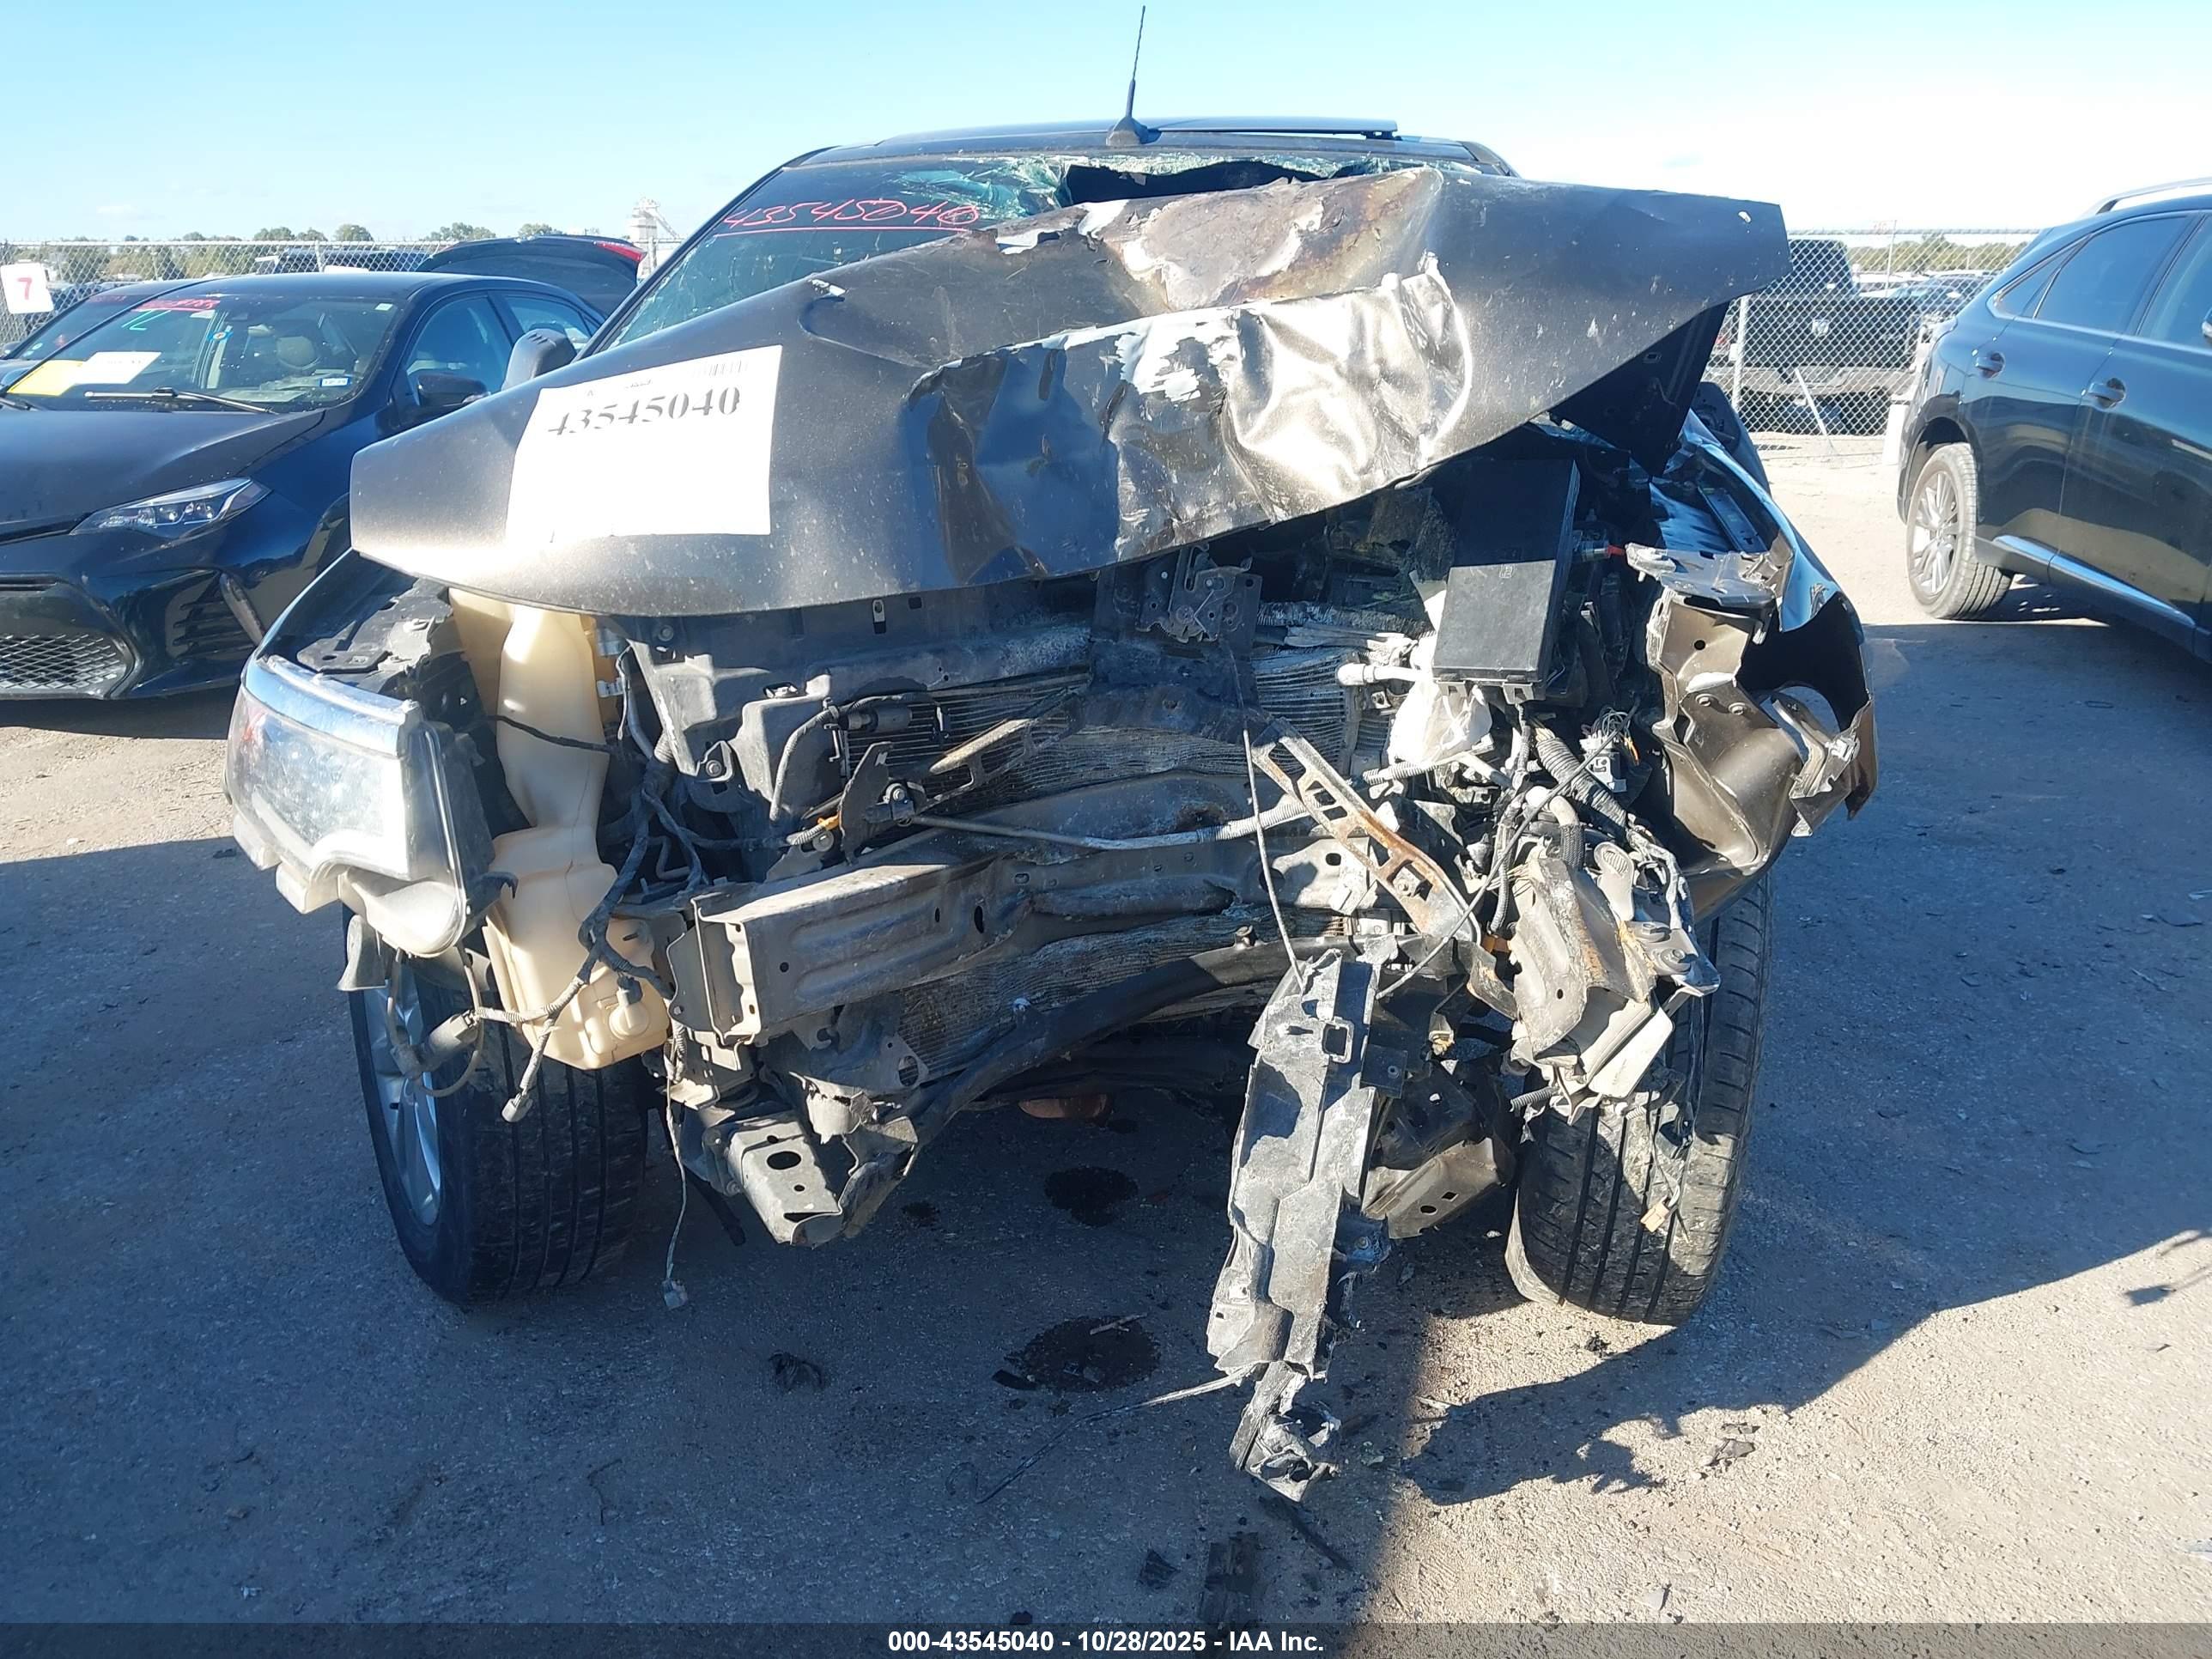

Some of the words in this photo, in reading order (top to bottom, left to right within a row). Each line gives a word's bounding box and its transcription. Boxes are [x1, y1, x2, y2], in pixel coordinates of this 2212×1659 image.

[723, 198, 979, 228] 43545040
[17, 276, 33, 301] 7
[548, 386, 741, 436] 43545040
